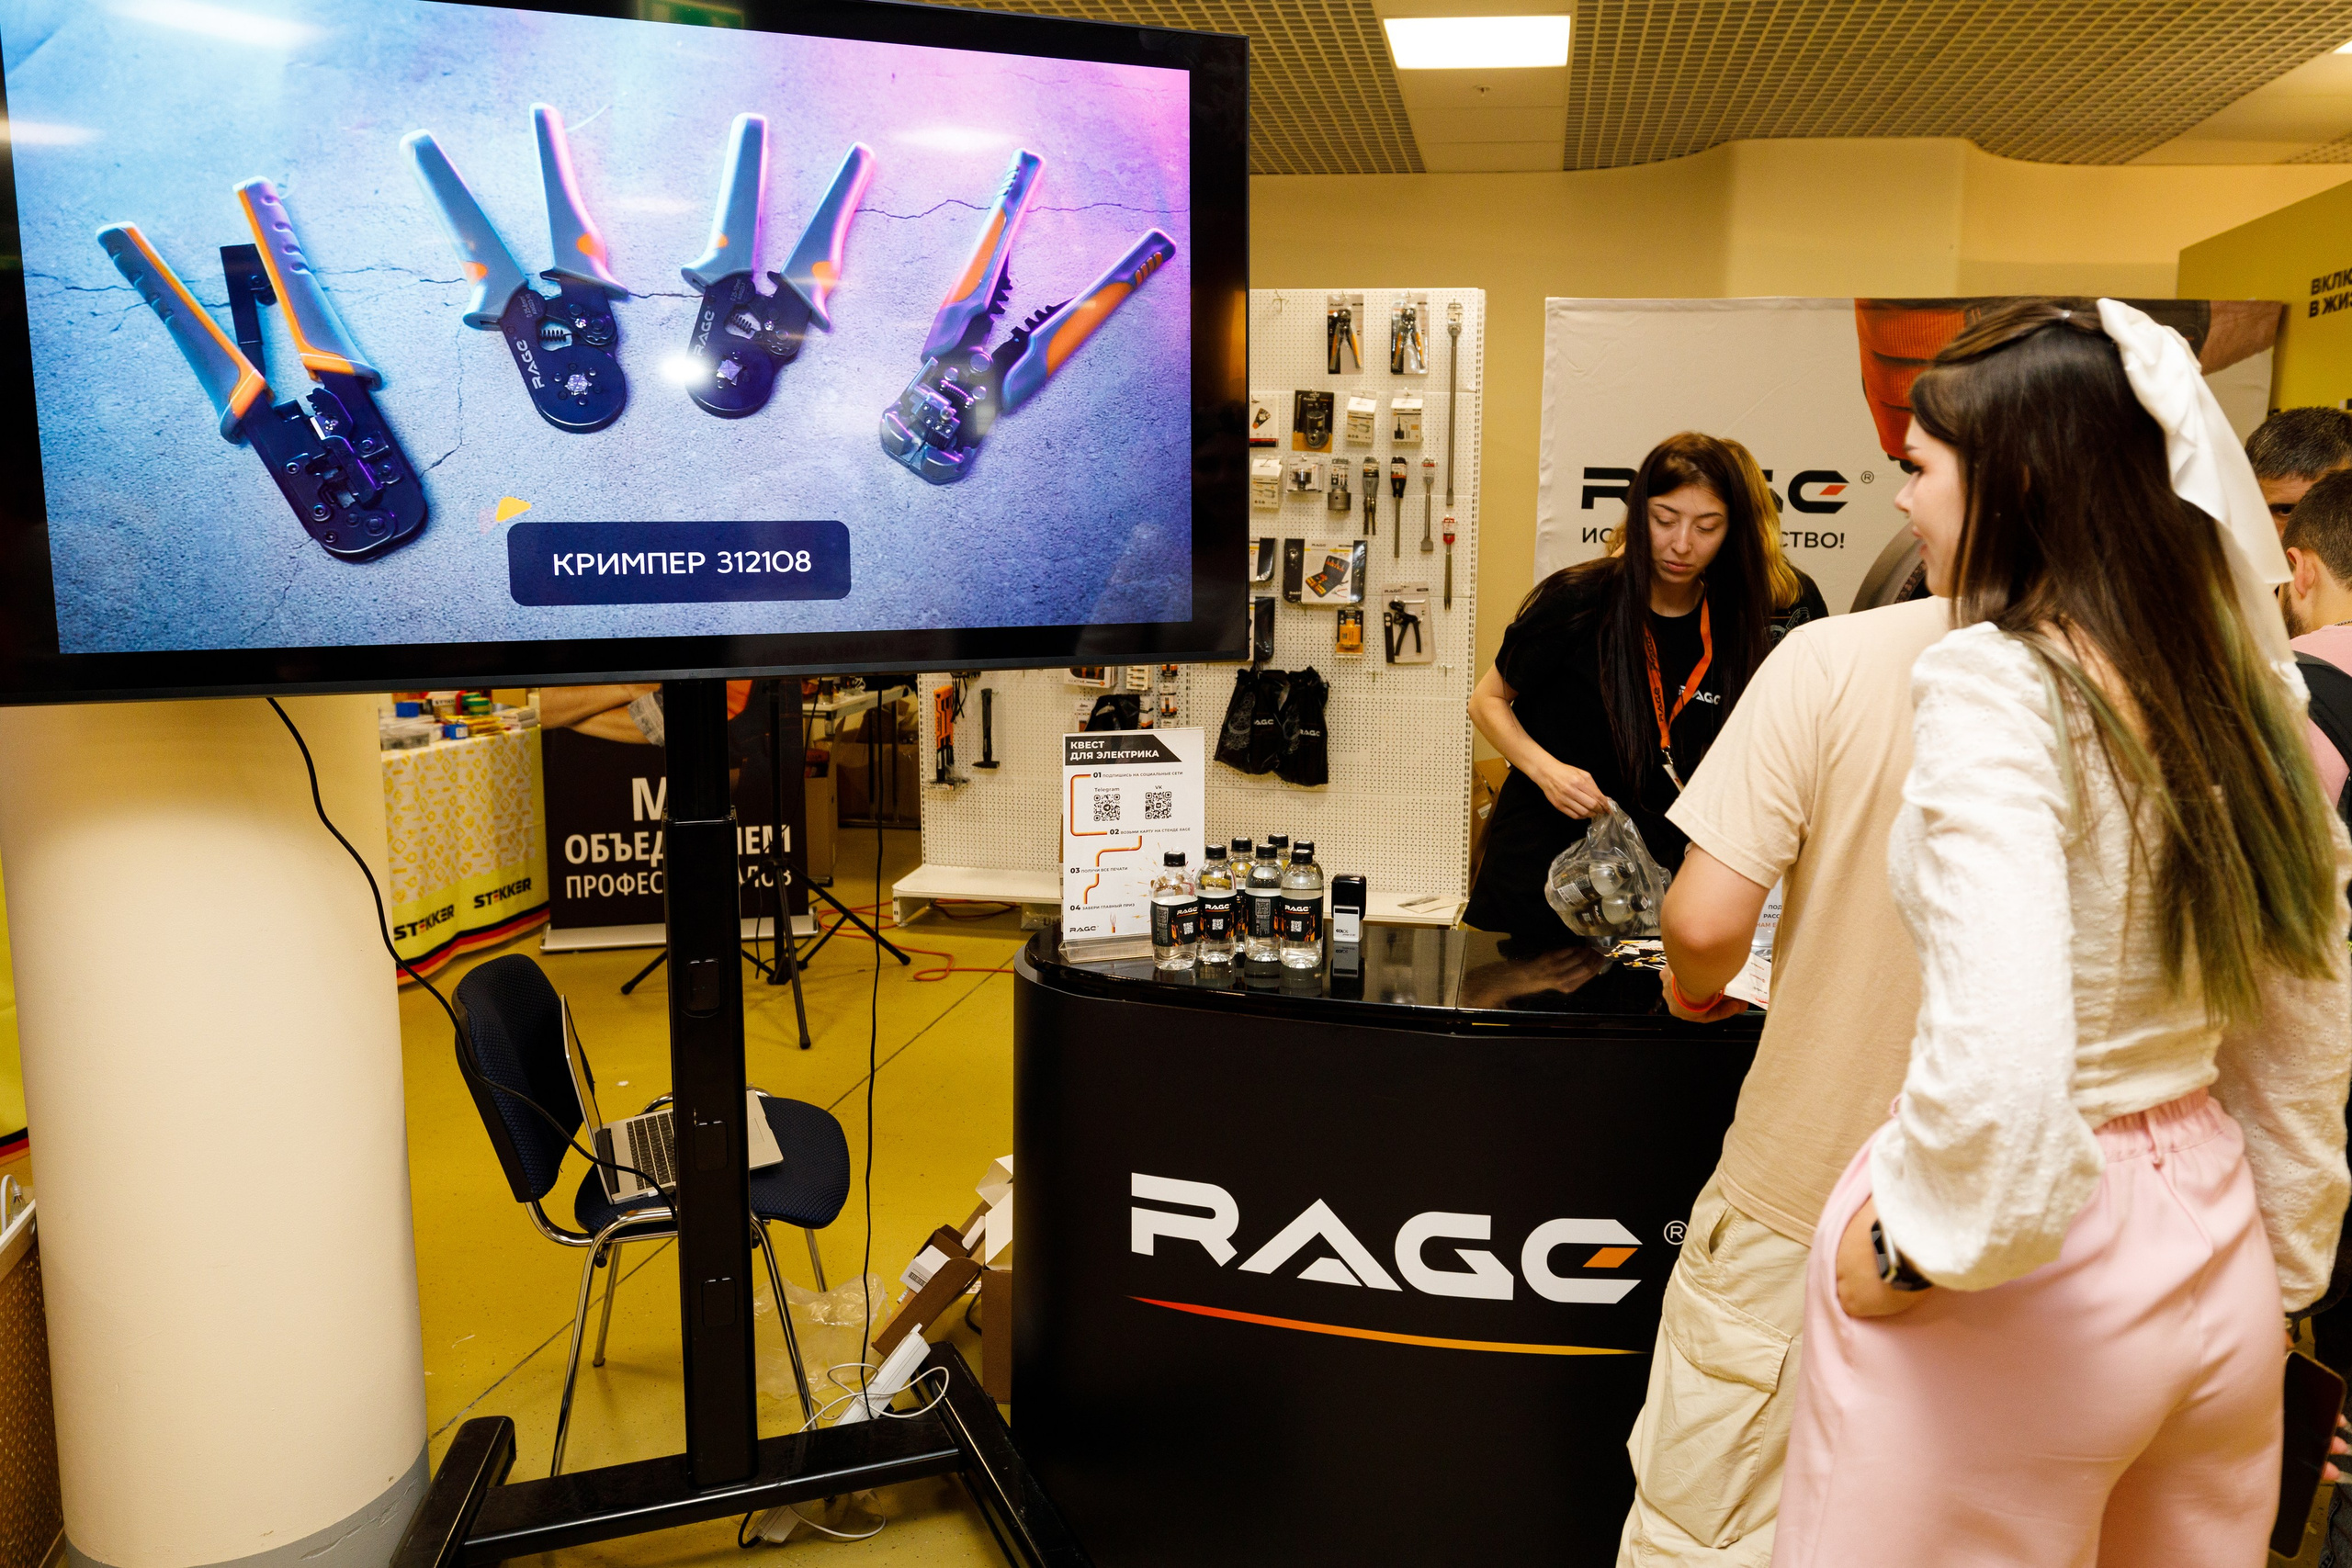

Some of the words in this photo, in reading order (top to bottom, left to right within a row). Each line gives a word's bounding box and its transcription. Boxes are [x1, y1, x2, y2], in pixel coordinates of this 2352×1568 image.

[2308, 299, 2320, 318] В
[553, 551, 706, 576] КРИМПЕР
[717, 550, 812, 574] 312108
[1070, 740, 1104, 750] КВЕСТ
[1070, 751, 1093, 761] ДЛЯ
[1096, 750, 1159, 759] ЭЛЕКТРИКА
[474, 877, 532, 908] STEKKER
[393, 904, 455, 941] STEKKER
[1131, 1171, 1645, 1305] RAGE
